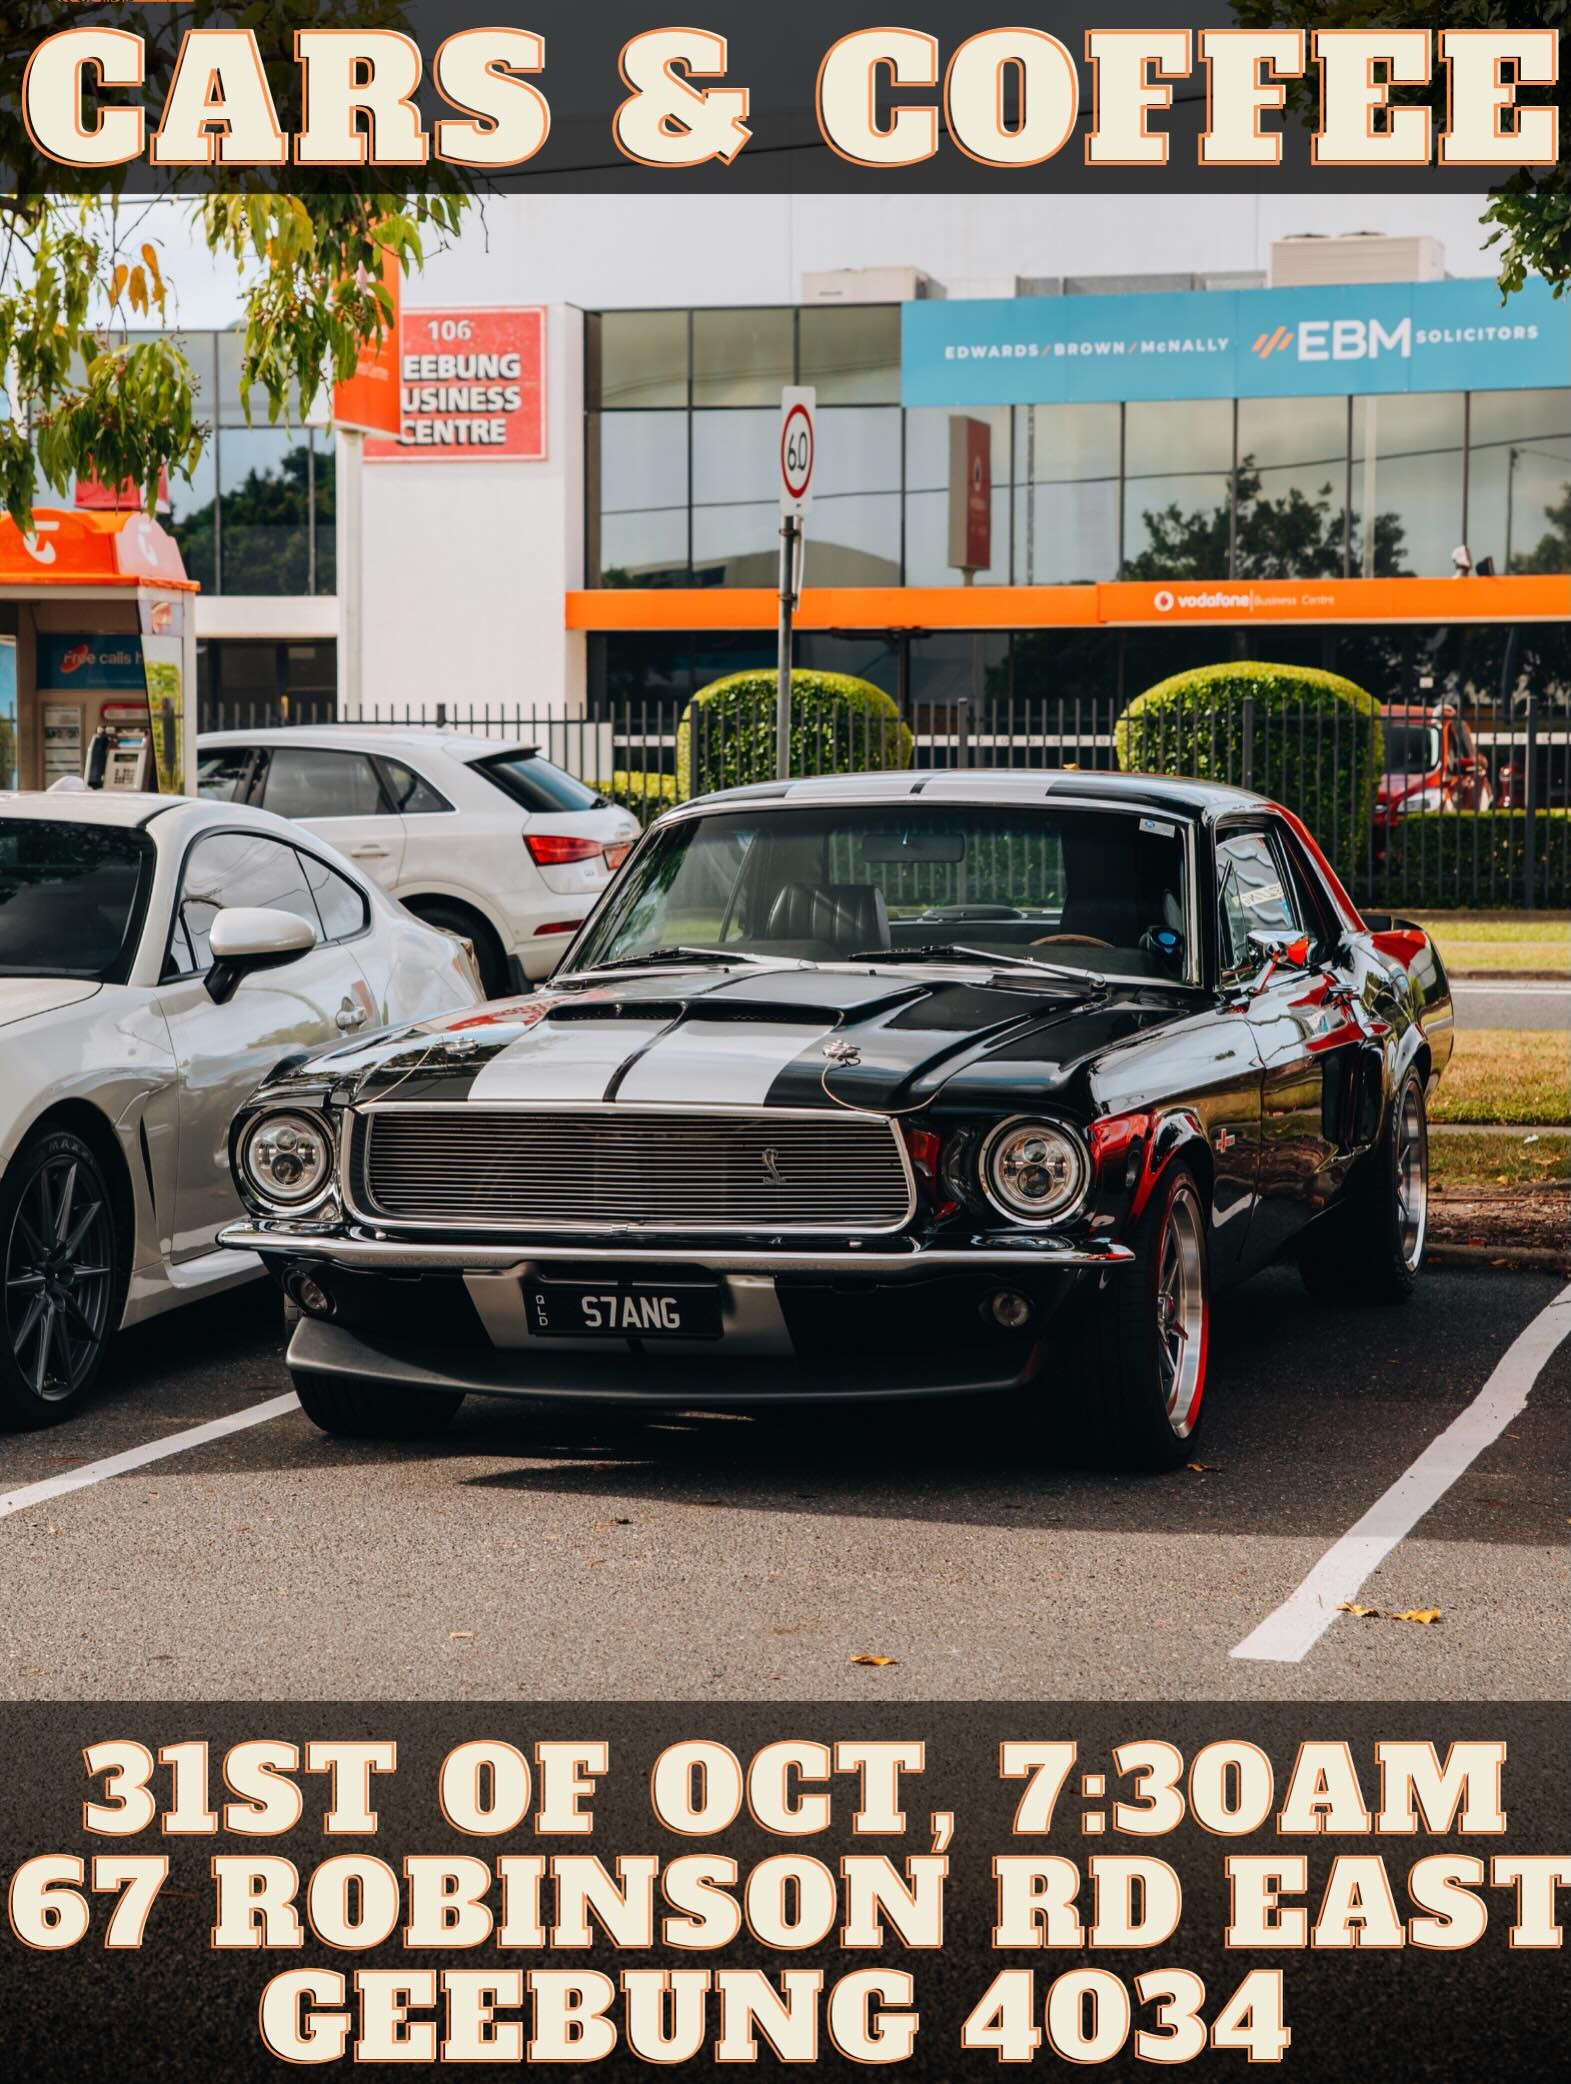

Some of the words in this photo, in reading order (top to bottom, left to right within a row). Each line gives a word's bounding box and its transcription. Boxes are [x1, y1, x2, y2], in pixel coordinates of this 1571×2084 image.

[428, 320, 472, 341] 106
[1297, 317, 1412, 362] EBM
[1416, 325, 1539, 344] SOLICITORS
[402, 353, 522, 380] EEBUNG
[401, 386, 522, 413] USINESS
[398, 418, 507, 445] CENTRE
[787, 431, 808, 471] 60
[1178, 592, 1249, 608] vodafone
[99, 651, 131, 665] calls
[536, 1295, 548, 1326] QLD
[581, 1296, 680, 1329] S7ANG
